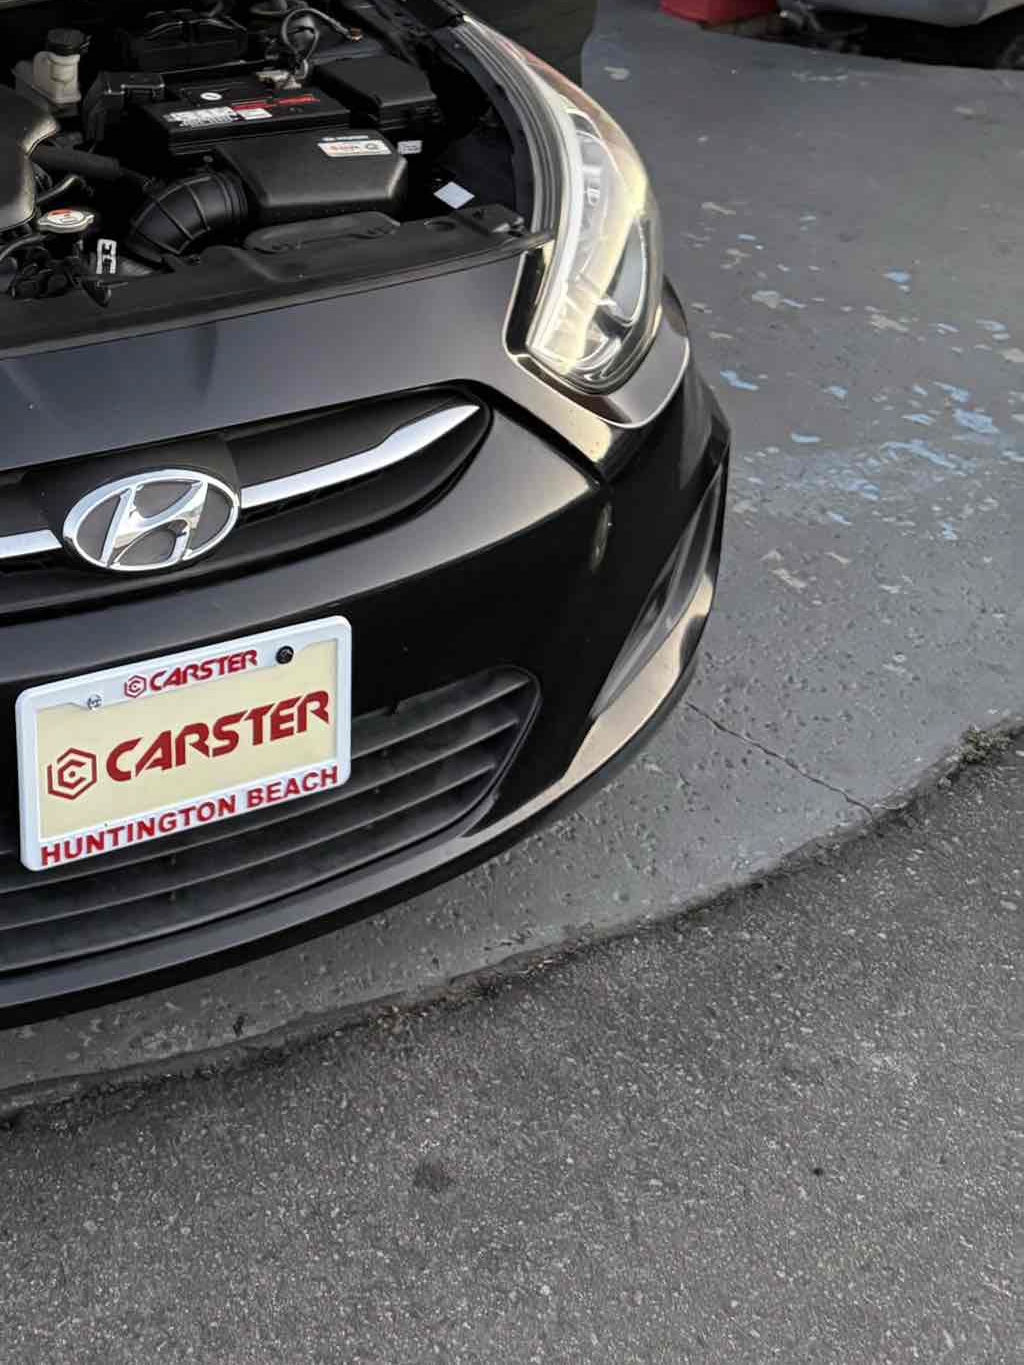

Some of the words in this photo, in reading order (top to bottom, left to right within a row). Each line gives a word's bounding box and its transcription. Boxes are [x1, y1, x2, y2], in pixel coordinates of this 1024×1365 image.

[149, 649, 258, 691] CARSTER
[105, 690, 330, 782] CARSTER
[40, 794, 236, 866] HUNTINGTON
[246, 766, 338, 809] BEACH
